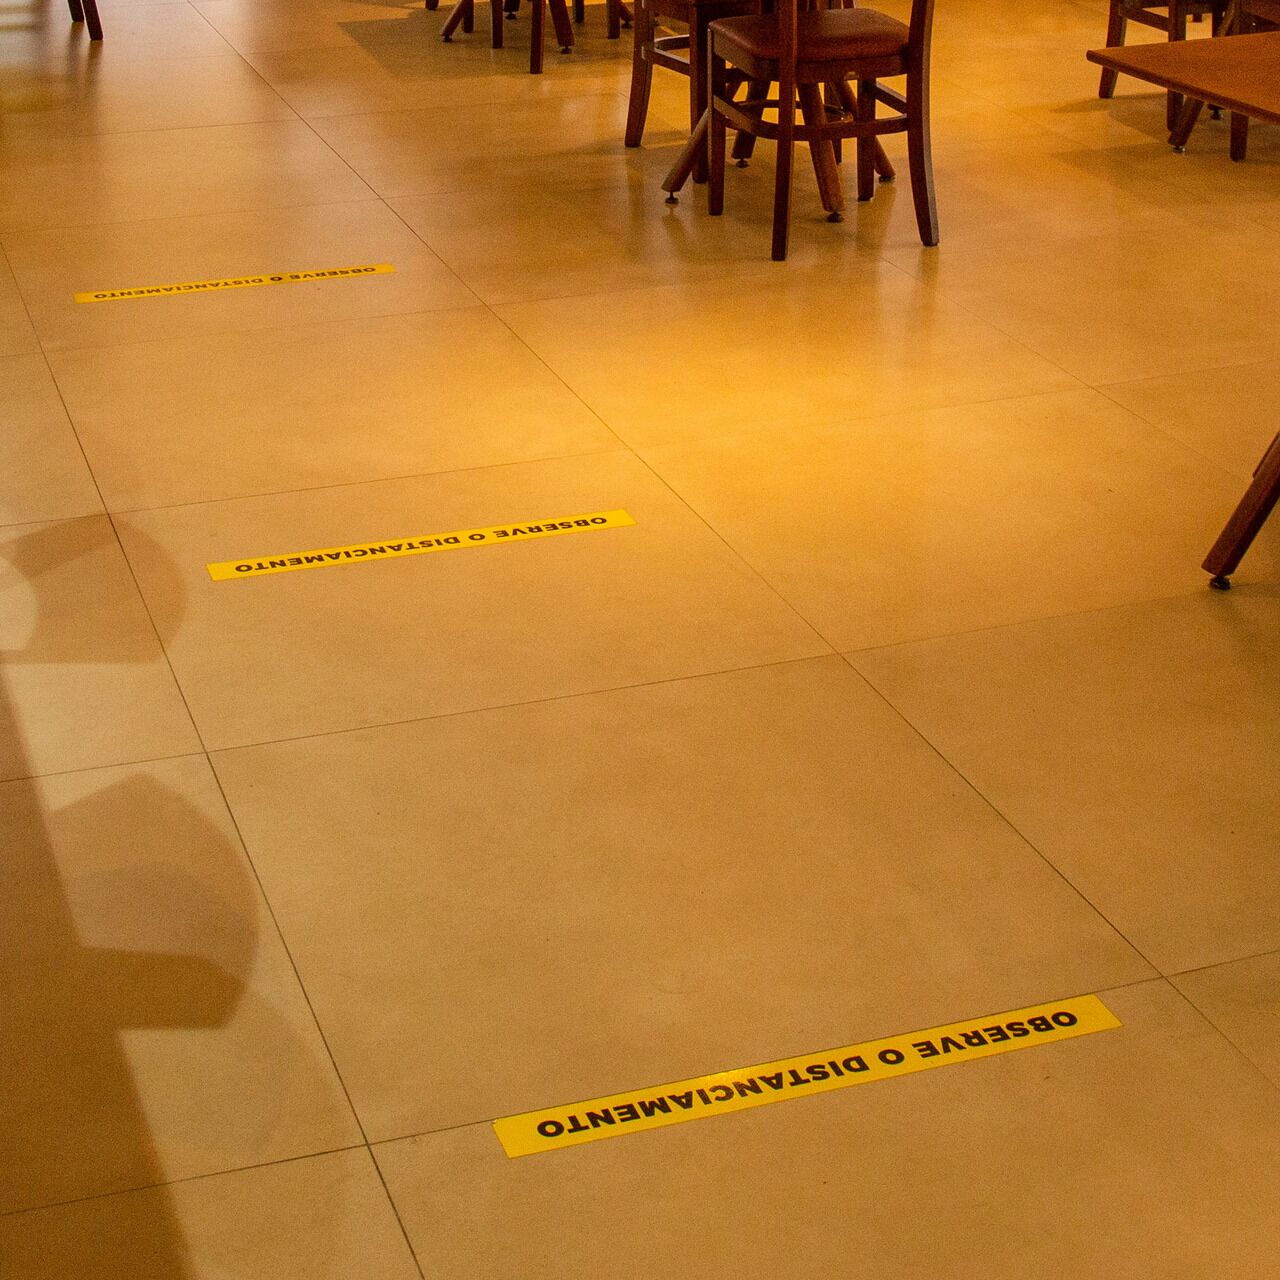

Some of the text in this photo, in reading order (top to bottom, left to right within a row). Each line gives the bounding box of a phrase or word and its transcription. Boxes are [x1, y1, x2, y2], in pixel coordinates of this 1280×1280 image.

[93, 277, 264, 299] DISTANCIAMENTO
[289, 266, 376, 280] OBSERVE
[234, 517, 608, 573] OBSERVE O DISTANCIAMENTO
[536, 1011, 1079, 1139] OBSERVE O DISTANCIAMENTO
